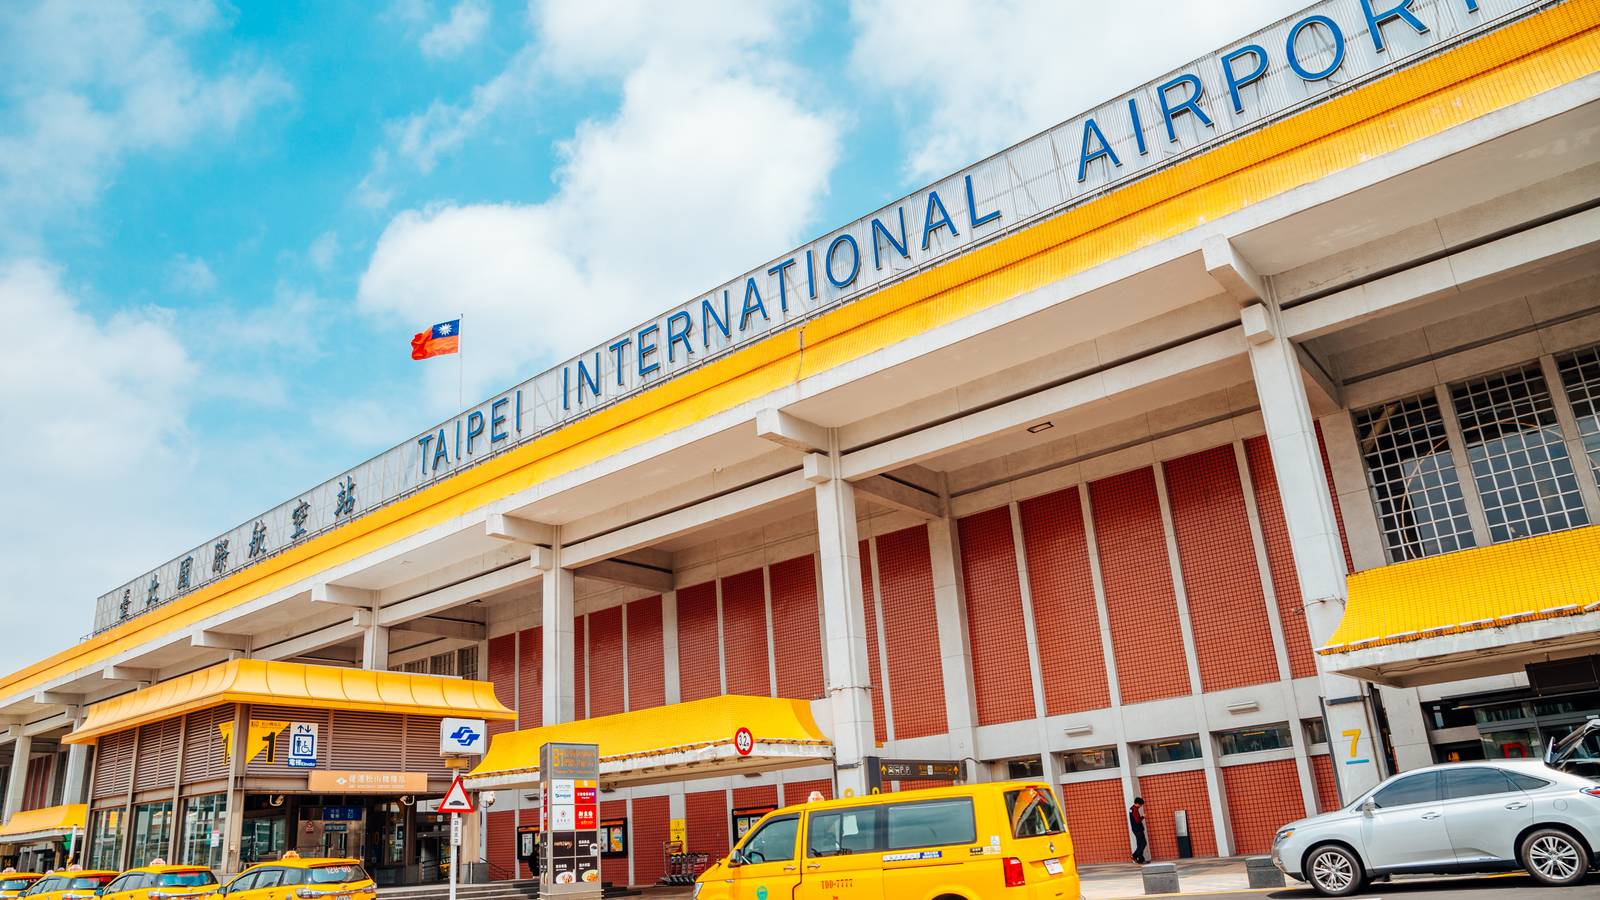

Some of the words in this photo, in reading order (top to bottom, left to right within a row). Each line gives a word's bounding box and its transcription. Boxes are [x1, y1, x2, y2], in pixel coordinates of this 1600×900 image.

[418, 390, 522, 475] TAIPEI
[563, 175, 1002, 411] INTERNATIONAL
[1077, 0, 1480, 182] AIRPOR
[262, 732, 275, 762] 1
[1342, 729, 1361, 757] 7
